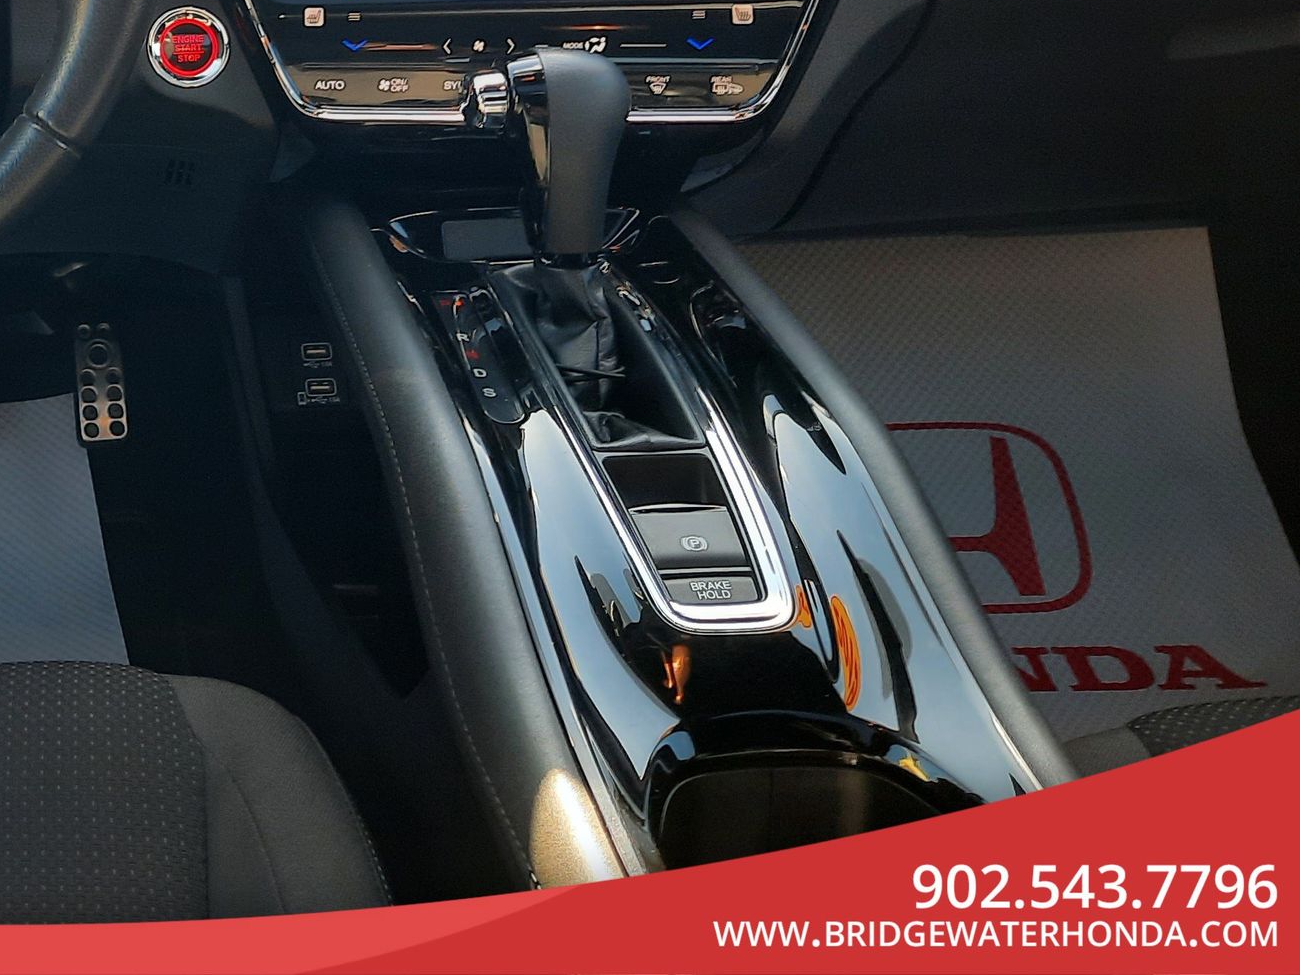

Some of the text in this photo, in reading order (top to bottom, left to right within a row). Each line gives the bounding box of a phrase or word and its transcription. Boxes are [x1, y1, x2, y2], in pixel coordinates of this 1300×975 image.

[171, 35, 204, 43] ENGINE
[563, 41, 583, 49] MODE
[315, 81, 345, 90] AUTO
[390, 84, 409, 92] OFF
[456, 333, 470, 341] R
[473, 368, 487, 378] D
[482, 388, 497, 397] S
[690, 581, 732, 591] BRAKE
[697, 590, 731, 600] HOLD
